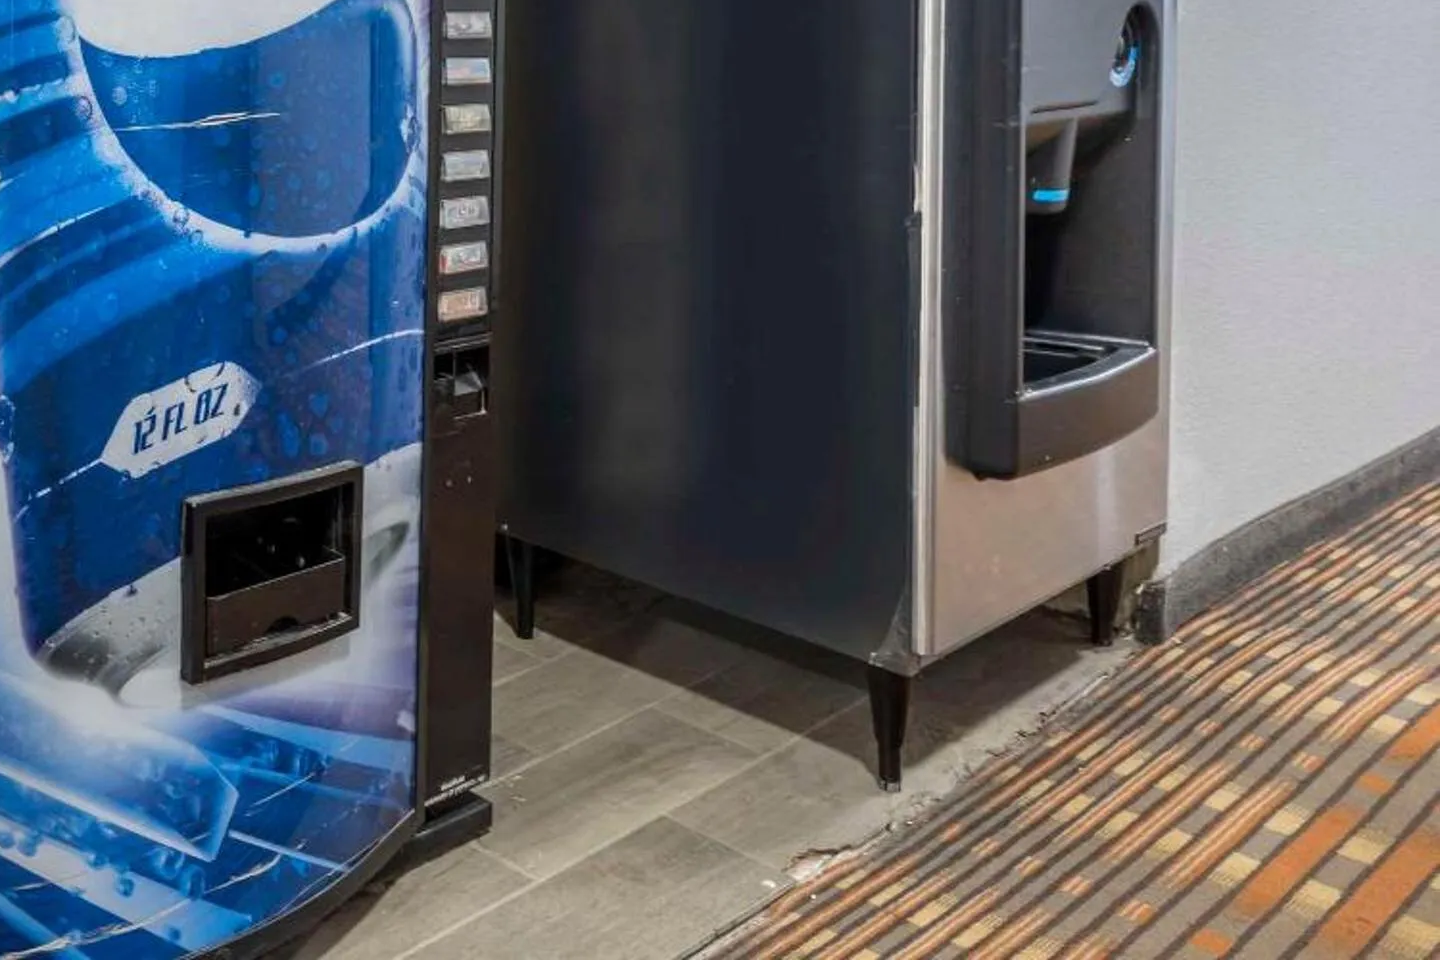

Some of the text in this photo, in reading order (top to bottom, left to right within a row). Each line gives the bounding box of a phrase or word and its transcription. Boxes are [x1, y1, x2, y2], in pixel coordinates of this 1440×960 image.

[132, 383, 230, 455] 12 FL OZ
